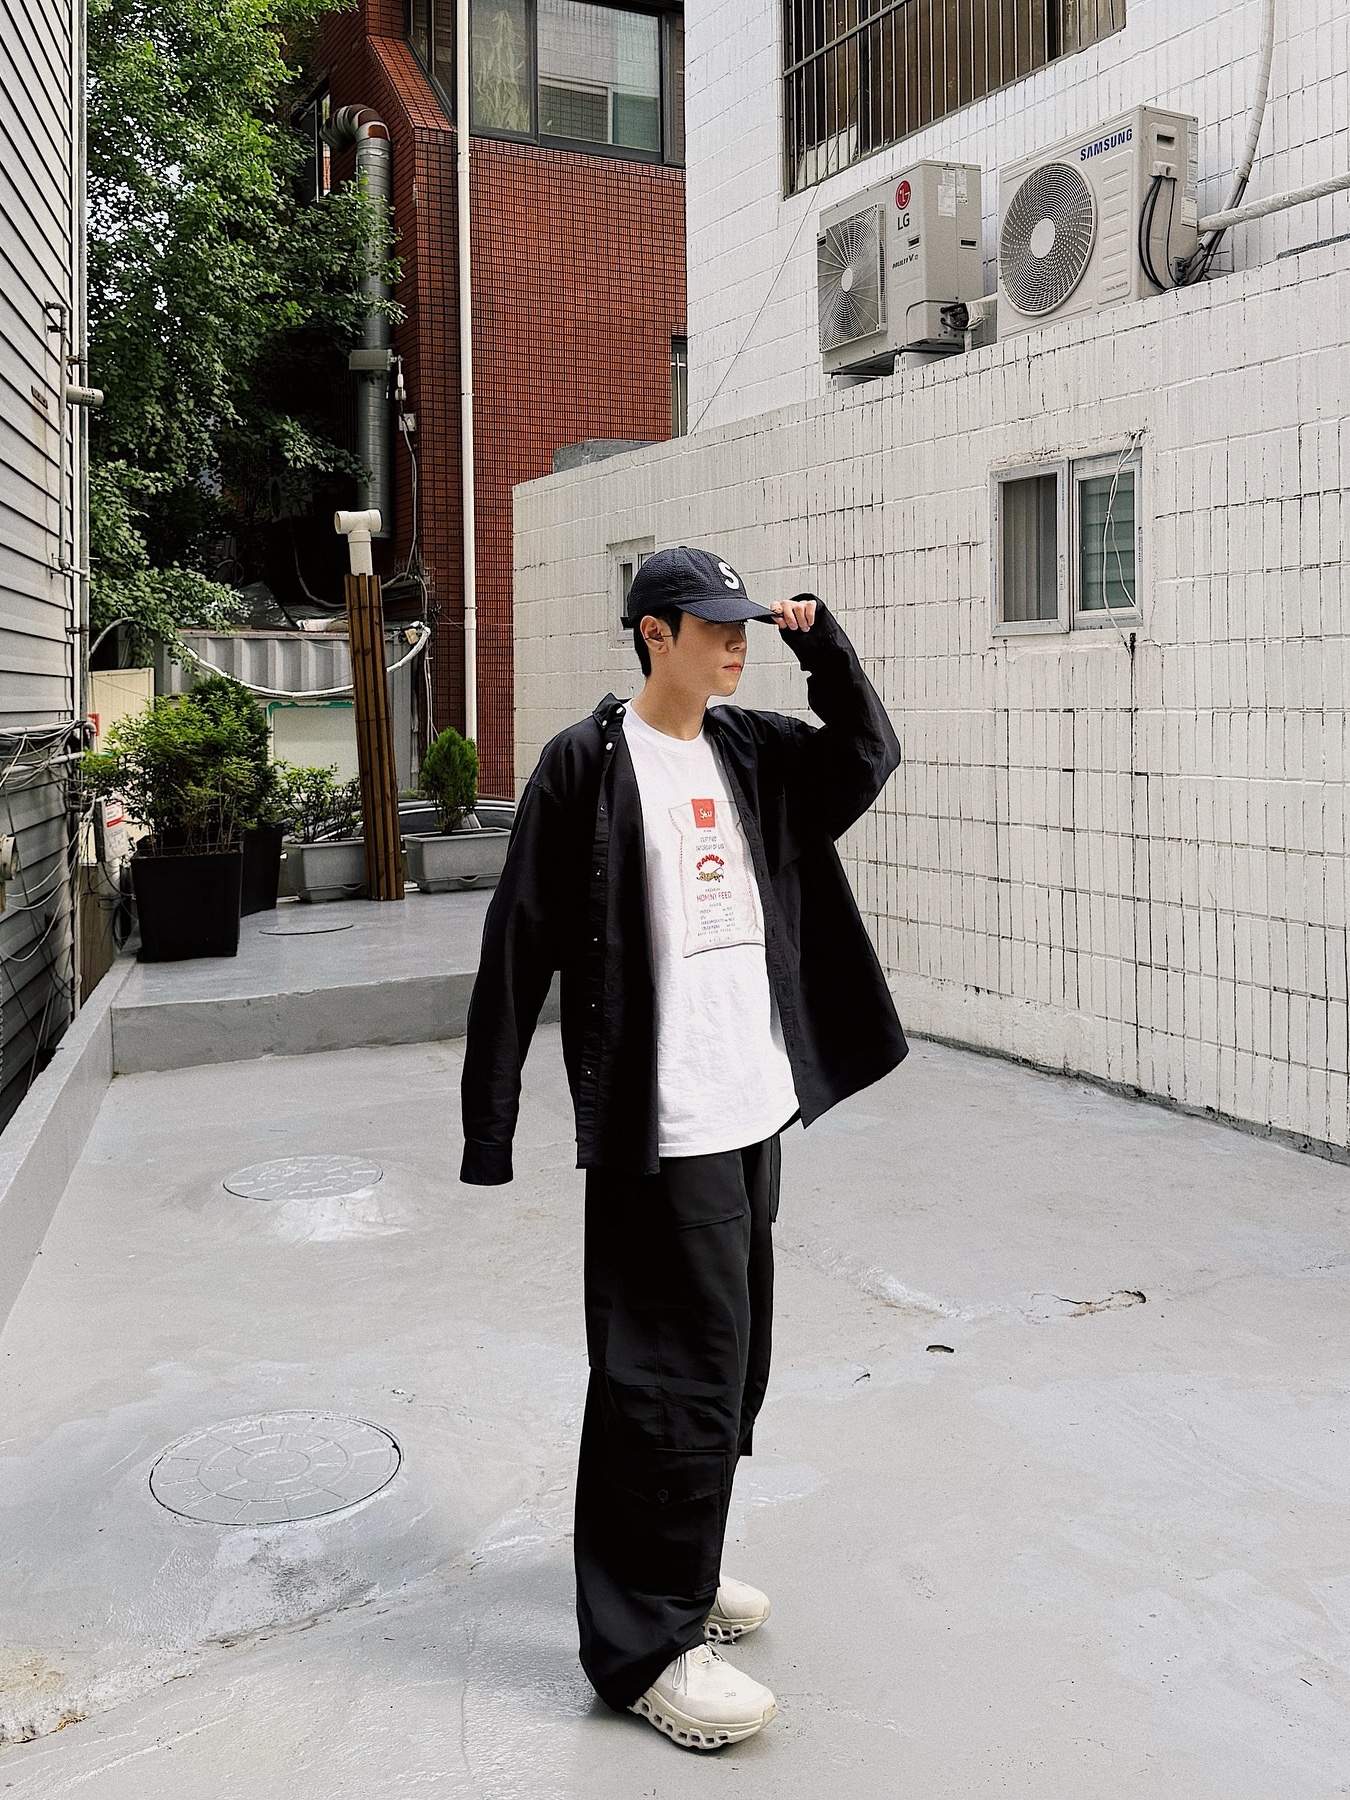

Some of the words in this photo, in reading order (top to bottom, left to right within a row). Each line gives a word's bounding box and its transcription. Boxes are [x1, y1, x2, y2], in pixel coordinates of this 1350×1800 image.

[1080, 129, 1132, 161] SAMSUNG
[898, 213, 910, 231] LG
[718, 562, 739, 589] S
[696, 854, 724, 870] RANGER
[718, 891, 732, 899] FEED
